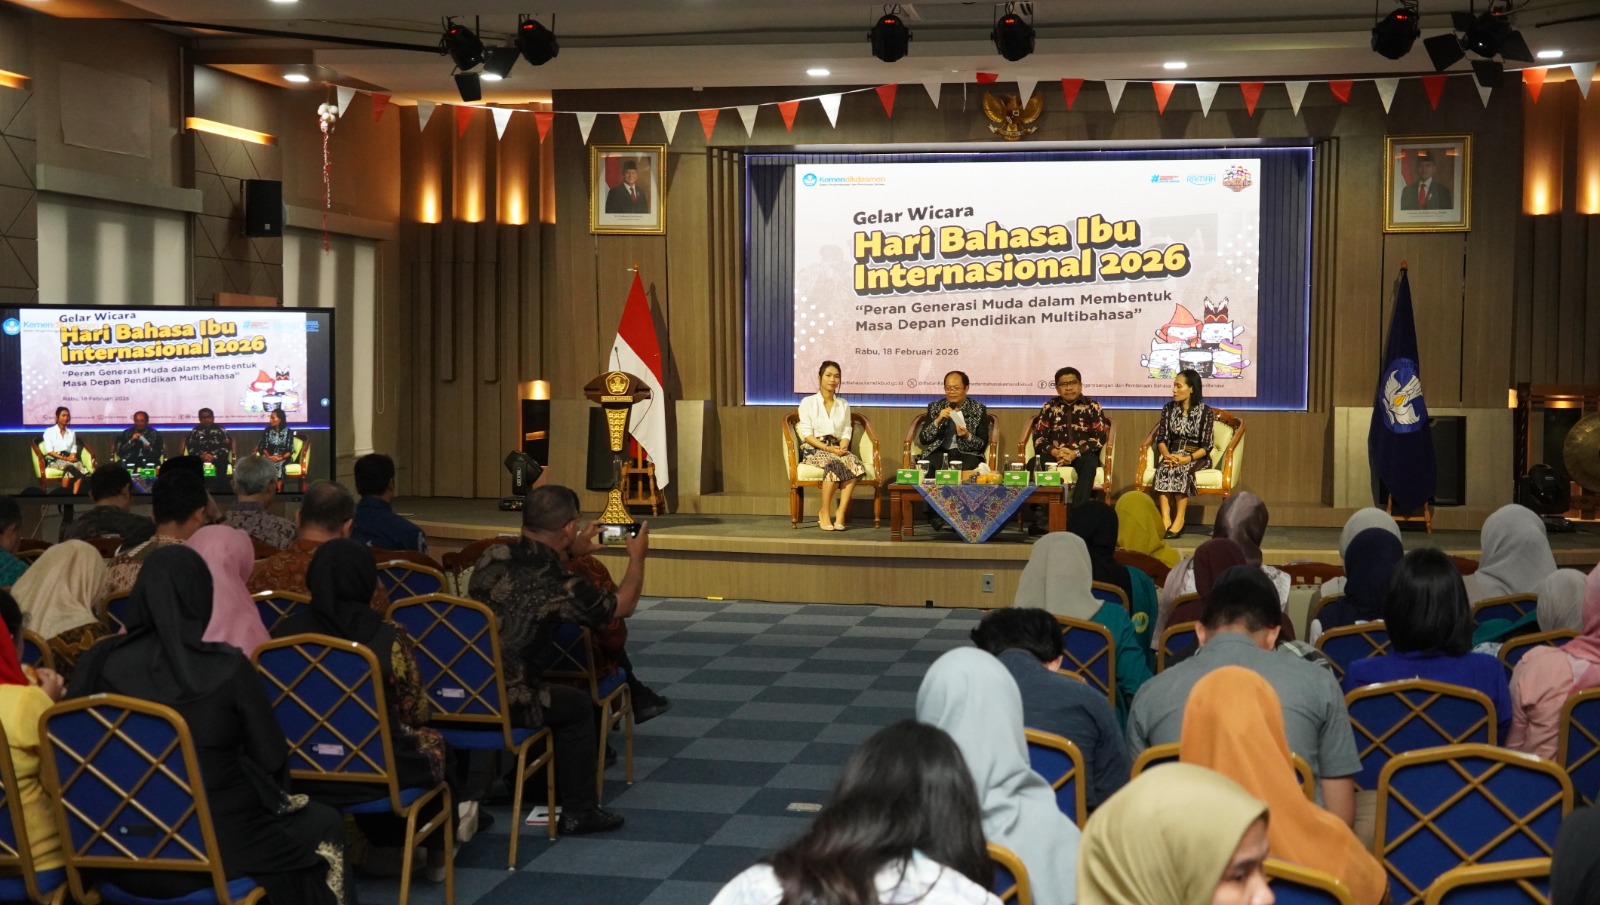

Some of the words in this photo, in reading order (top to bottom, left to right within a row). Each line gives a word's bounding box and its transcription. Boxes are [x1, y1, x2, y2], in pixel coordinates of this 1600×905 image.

[819, 175, 886, 183] Kemendikdasmen
[853, 209, 903, 225] Gelar
[907, 205, 974, 221] Wicara
[854, 225, 935, 263] Hari
[940, 221, 1072, 259] Bahasa
[1077, 214, 1141, 249] Ibu
[854, 248, 1096, 295] Internasional
[1100, 243, 1191, 281] 2026
[856, 304, 906, 315] “Peran
[911, 299, 976, 313] Generasi
[982, 298, 1023, 310] Muda
[1028, 296, 1075, 308] dalam
[1080, 290, 1172, 305] Membentuk
[59, 314, 92, 323] Gelar
[94, 312, 136, 321] Wicara
[856, 321, 892, 331] Masa
[898, 318, 946, 331] Depan
[951, 314, 1036, 328] Pendidikan
[1041, 308, 1142, 323] Multibahasa”
[60, 323, 112, 346] Hari
[115, 321, 197, 343] Bahasa
[199, 318, 238, 338] Ibu
[60, 338, 212, 364] Internasional
[213, 335, 267, 356] 2026
[855, 348, 880, 356] Rabu,
[883, 348, 893, 356] 18
[895, 348, 933, 356] Februari
[935, 348, 959, 356] 2026
[90, 379, 121, 387] Depan
[124, 376, 177, 384] Pendidikan
[179, 372, 240, 381] Multibahasa”
[99, 367, 140, 376] Generasi
[143, 366, 168, 374] Muda
[171, 365, 200, 373] dalam
[203, 362, 257, 371] Membentuk
